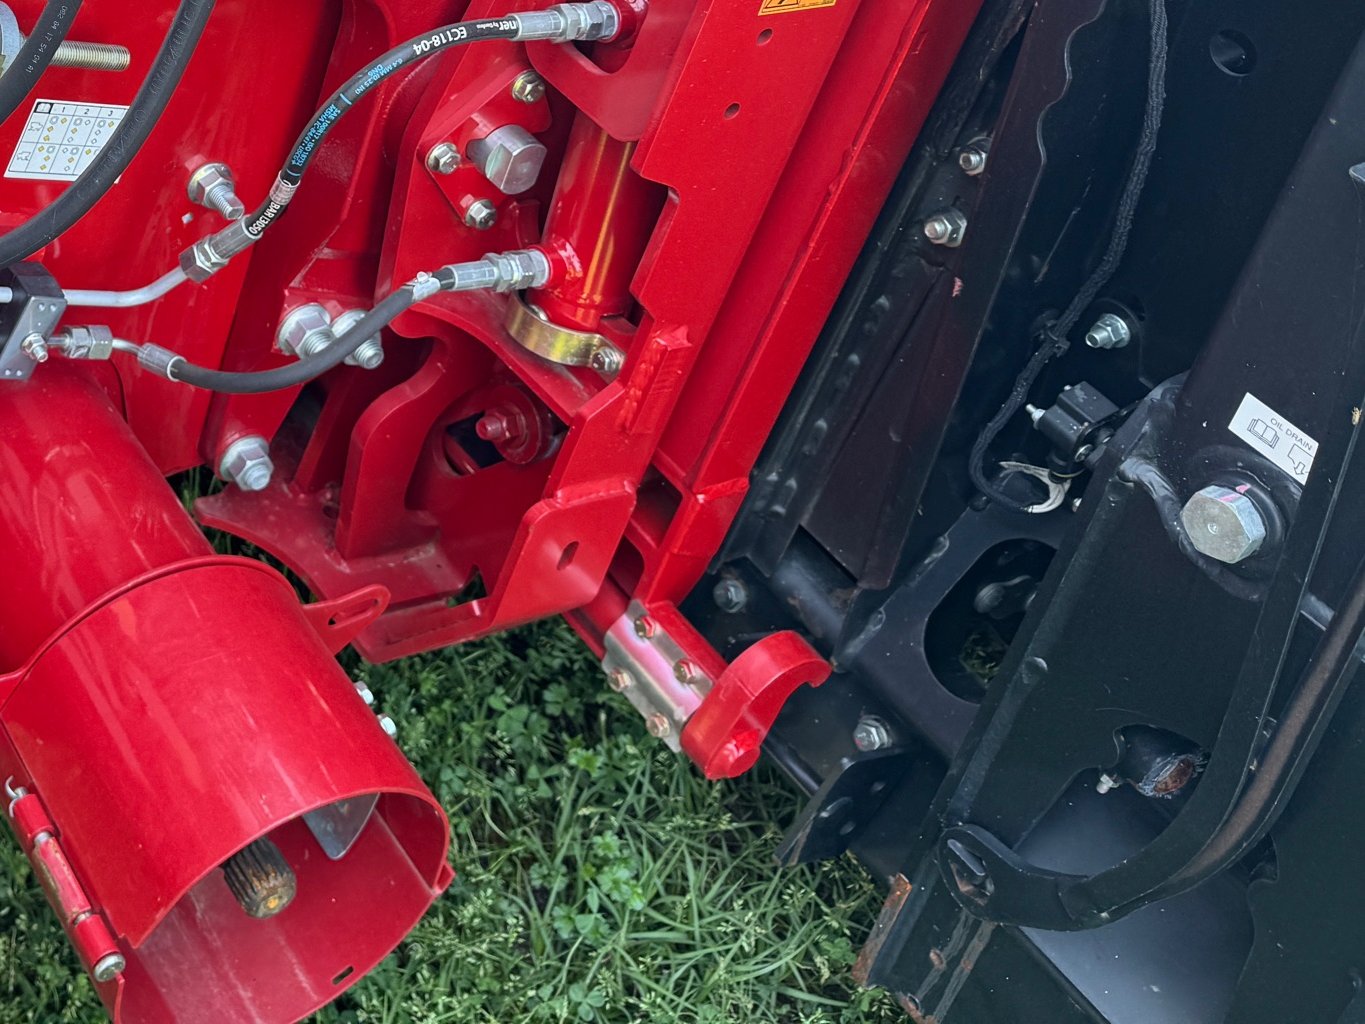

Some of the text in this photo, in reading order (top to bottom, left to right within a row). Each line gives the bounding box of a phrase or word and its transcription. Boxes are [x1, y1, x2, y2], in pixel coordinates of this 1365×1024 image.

[411, 25, 468, 55] EC118-04
[378, 64, 393, 76] MM
[317, 103, 335, 123] MSHA
[327, 106, 341, 121] SAE
[303, 140, 315, 152] ISO
[263, 200, 280, 218] BAR
[1270, 418, 1313, 450] OIL DRAIN
